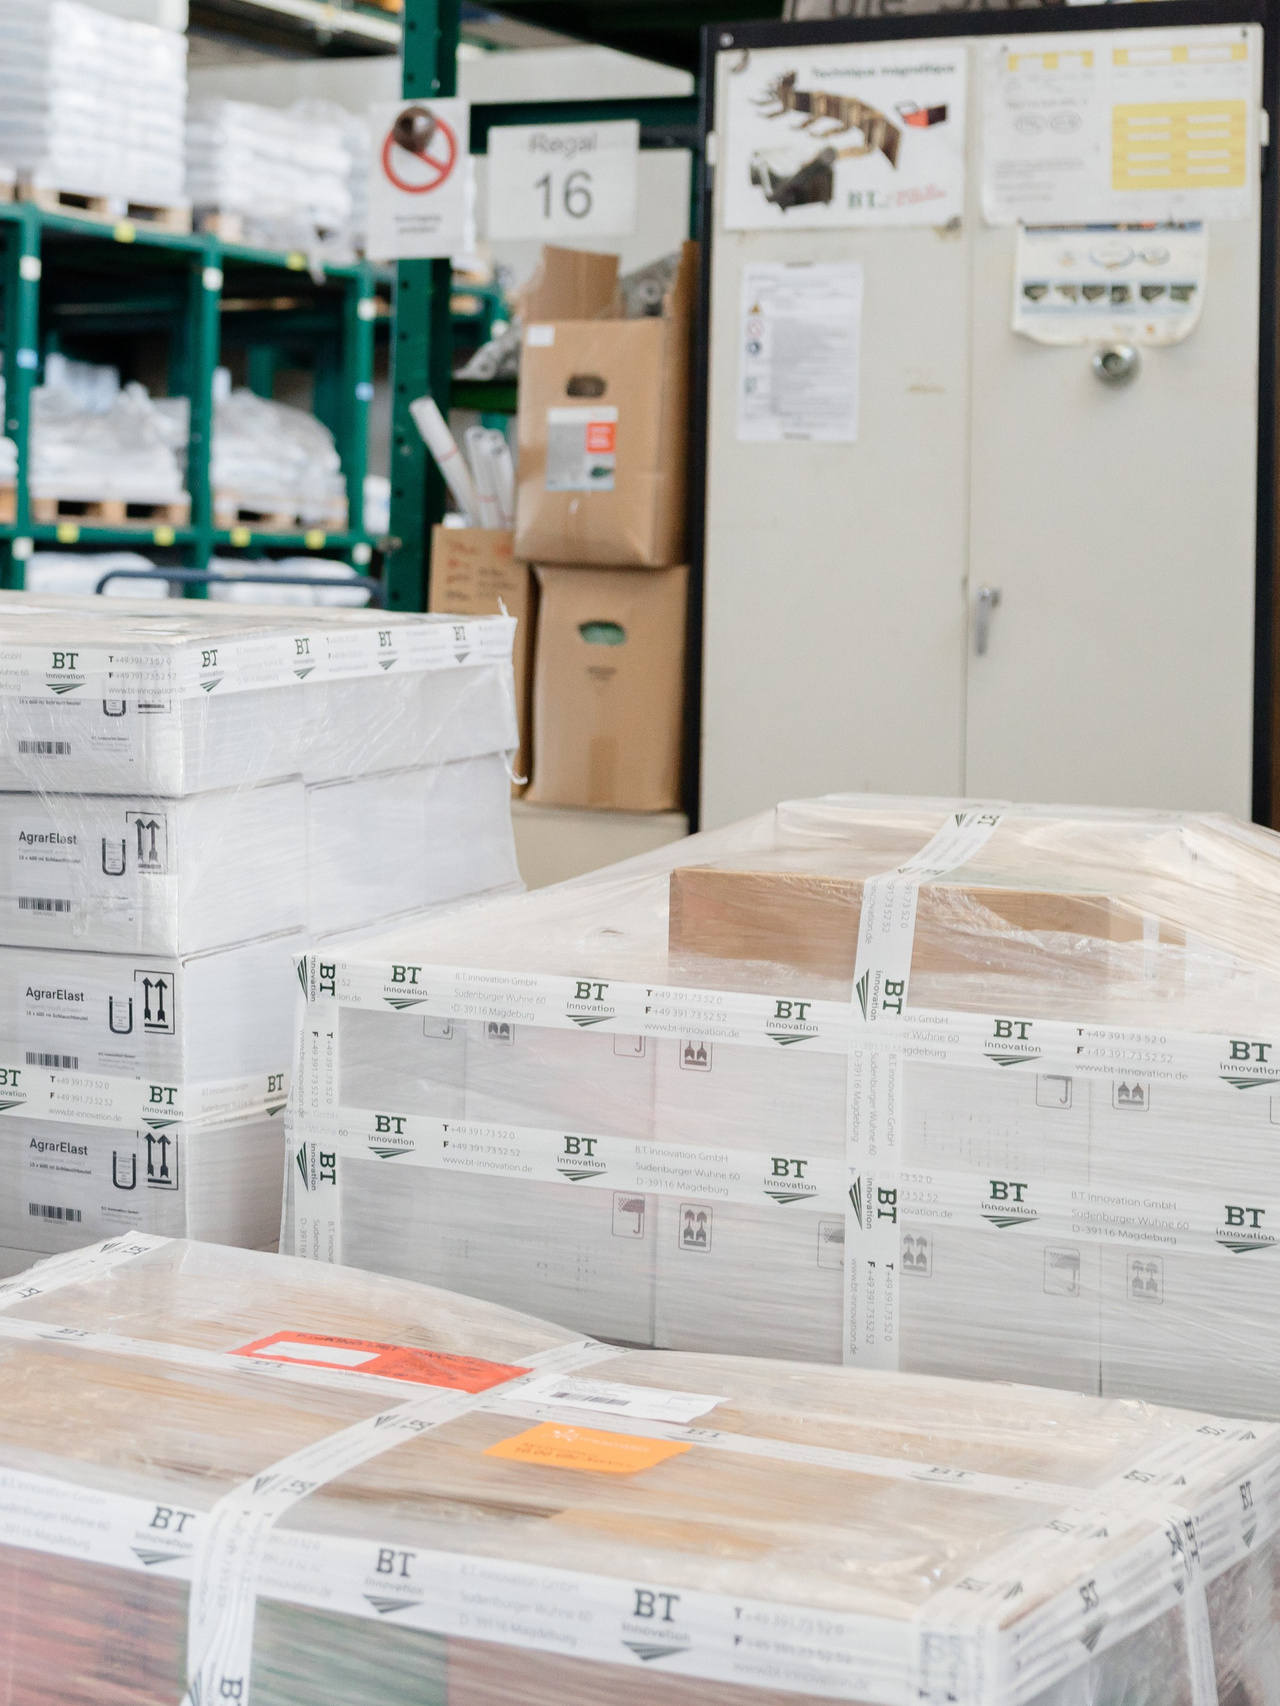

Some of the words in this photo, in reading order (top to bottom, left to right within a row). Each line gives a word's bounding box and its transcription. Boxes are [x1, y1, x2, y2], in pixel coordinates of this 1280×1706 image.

[530, 132, 598, 157] Regal
[535, 171, 593, 220] 16
[378, 631, 392, 646] BT
[453, 626, 466, 641] BT
[294, 638, 310, 654] BT
[52, 652, 78, 670] BT
[201, 650, 218, 667] BT
[46, 672, 85, 680] innovation
[19, 831, 77, 845] AgrarElast
[320, 962, 336, 996] BT
[391, 965, 422, 984] BT
[455, 972, 467, 981] B.T.
[511, 977, 538, 987] GmbH
[26, 987, 84, 1002] AgrarElast
[383, 985, 428, 996] innovation
[506, 992, 535, 1003] Wuhne
[536, 995, 546, 1004] 60
[574, 982, 609, 1001] BT
[654, 991, 670, 1000] +49
[672, 992, 701, 1003] 391.73
[704, 994, 714, 1004] 52
[716, 995, 722, 1004] 0
[871, 970, 883, 1020] innovation
[882, 979, 905, 1014] BT
[566, 1002, 615, 1014] innovation
[645, 1006, 652, 1014] F
[654, 1007, 669, 1017] +49
[671, 1009, 700, 1020] 391.73
[703, 1011, 713, 1021] 52
[716, 1012, 727, 1022] 52
[774, 1000, 811, 1020] BT
[766, 1020, 818, 1032] innovation
[918, 1014, 949, 1024] GmbH
[912, 1030, 946, 1042] Wuhne
[948, 1034, 960, 1042] 60
[994, 1019, 1032, 1040] BT
[1076, 1028, 1084, 1036] T
[1087, 1030, 1105, 1039] +49
[1108, 1032, 1141, 1042] 391.73
[1145, 1034, 1156, 1043] 52
[1160, 1035, 1166, 1044] 0
[984, 1040, 1041, 1052] innovation
[1076, 1046, 1084, 1054] F
[1087, 1048, 1105, 1057] +49
[1107, 1049, 1142, 1060] 391.73
[1145, 1052, 1157, 1061] 52
[1160, 1054, 1173, 1063] 52
[1230, 1040, 1272, 1062] BT
[854, 1050, 862, 1088] D-39116
[1220, 1062, 1280, 1076] innovation
[268, 1073, 284, 1092] BT
[868, 1052, 879, 1108] Sudenburger
[149, 1086, 178, 1106] BT
[142, 1106, 184, 1118] innovation
[851, 1091, 862, 1142] Magdeburg
[375, 1114, 406, 1134] BT
[442, 1124, 449, 1132] T
[450, 1126, 466, 1135] +49
[468, 1128, 495, 1138] 391.73
[498, 1130, 507, 1139] 52
[510, 1131, 516, 1140] 0
[869, 1111, 877, 1142] Wuhne
[30, 1138, 88, 1156] AgrarElast
[368, 1134, 414, 1146] innovation
[564, 1136, 597, 1157] BT
[452, 1143, 466, 1152] +49
[468, 1144, 496, 1154] 391.73
[498, 1147, 508, 1156] 52
[510, 1148, 521, 1157] 52
[635, 1146, 648, 1155] B.T.
[650, 1147, 697, 1159] innovation
[699, 1151, 728, 1162] GmbH
[869, 1144, 877, 1156] 60
[320, 1152, 336, 1186] BT
[557, 1156, 606, 1168] innovation
[771, 1158, 808, 1178] BT
[636, 1162, 693, 1178] Sudenburger
[695, 1167, 727, 1180] Wuhne
[729, 1170, 740, 1181] 60
[636, 1177, 675, 1189] D-39116
[677, 1181, 730, 1196] Magdeburg
[764, 1178, 816, 1192] innovation
[990, 1180, 1028, 1202] BT
[878, 1187, 898, 1224] BT
[982, 1201, 1037, 1215] innovation
[1070, 1191, 1086, 1201] B.T.
[1087, 1192, 1141, 1207] innovation
[1143, 1198, 1177, 1210] GmbH
[1070, 1209, 1136, 1227] Sudenburger
[1138, 1215, 1174, 1229] Wuhne
[1177, 1219, 1190, 1230] 60
[1224, 1205, 1266, 1228] BT
[1072, 1224, 1116, 1237] D-39116
[1118, 1228, 1177, 1246] Magdeburg
[1216, 1228, 1275, 1242] innovation
[150, 1506, 195, 1533] BT
[376, 1548, 416, 1578] BT
[633, 1588, 680, 1622] BT
